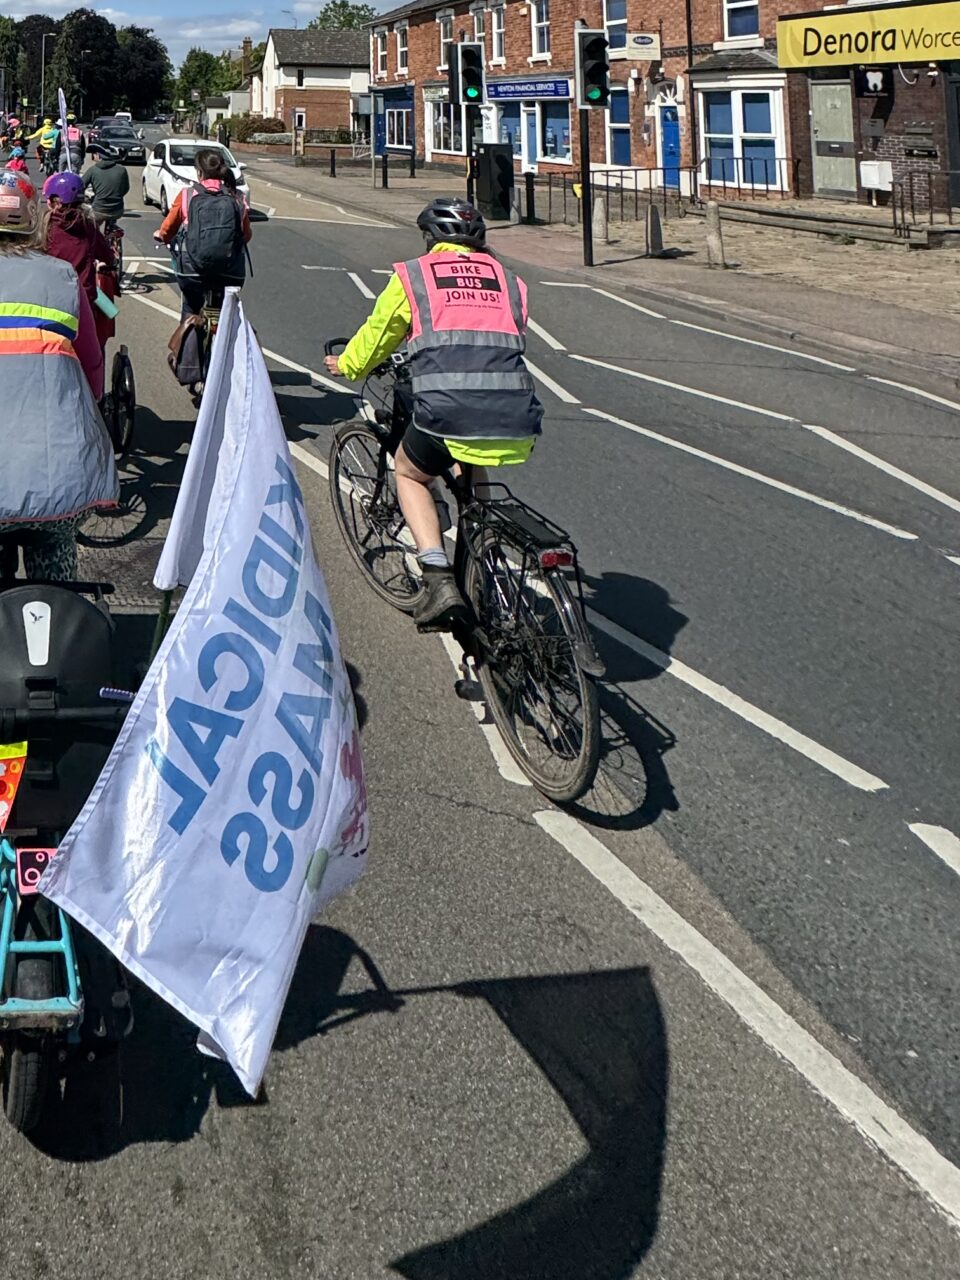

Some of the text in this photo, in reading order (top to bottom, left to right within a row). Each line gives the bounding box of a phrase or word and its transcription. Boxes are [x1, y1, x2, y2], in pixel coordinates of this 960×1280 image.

[803, 27, 897, 56] Denora
[450, 265, 481, 275] BIKE
[456, 277, 483, 288] BUS
[445, 291, 501, 303] JOIN US!
